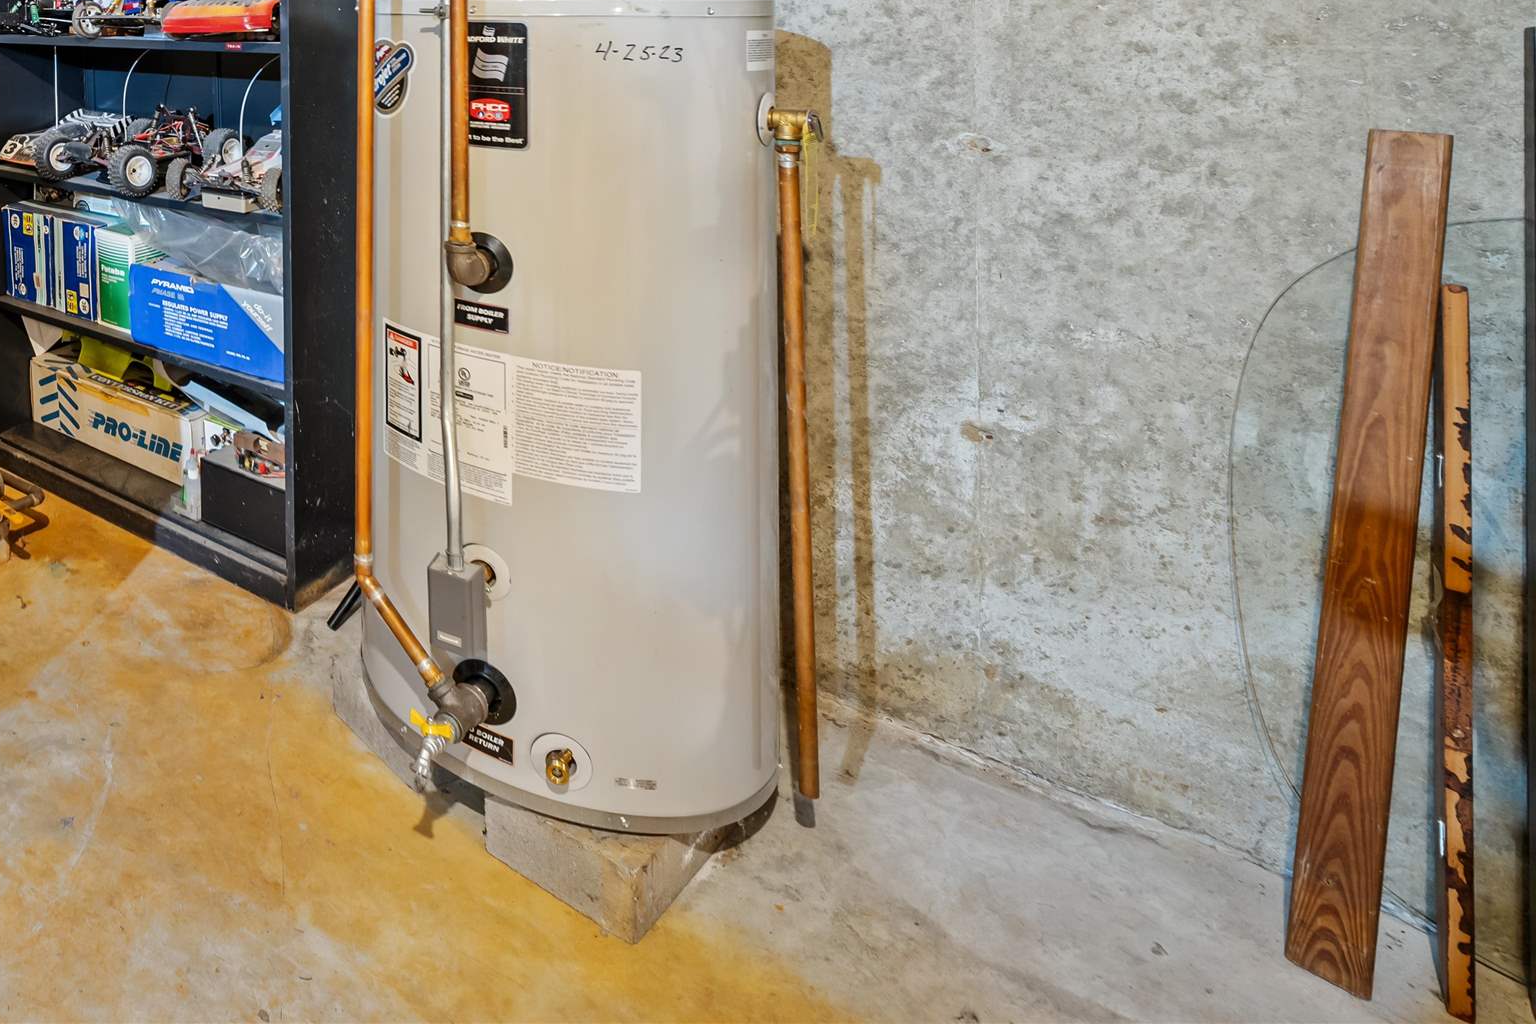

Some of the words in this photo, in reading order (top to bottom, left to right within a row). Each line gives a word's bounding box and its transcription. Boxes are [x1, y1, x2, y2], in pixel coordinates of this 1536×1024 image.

[467, 36, 496, 44] ADFORD
[471, 102, 510, 112] PHCC
[4, 142, 18, 155] 3
[151, 278, 195, 295] PYRAMID
[162, 299, 190, 311] REGULATED
[189, 306, 209, 317] POWER
[209, 311, 229, 322] SUPPLY
[242, 300, 274, 332] yourself
[253, 303, 273, 323] do-it
[457, 303, 478, 314] FROM
[478, 306, 505, 318] BOILER
[466, 313, 494, 324] SUPPLY
[468, 734, 501, 753] RETURN
[476, 728, 505, 747] BOILER
